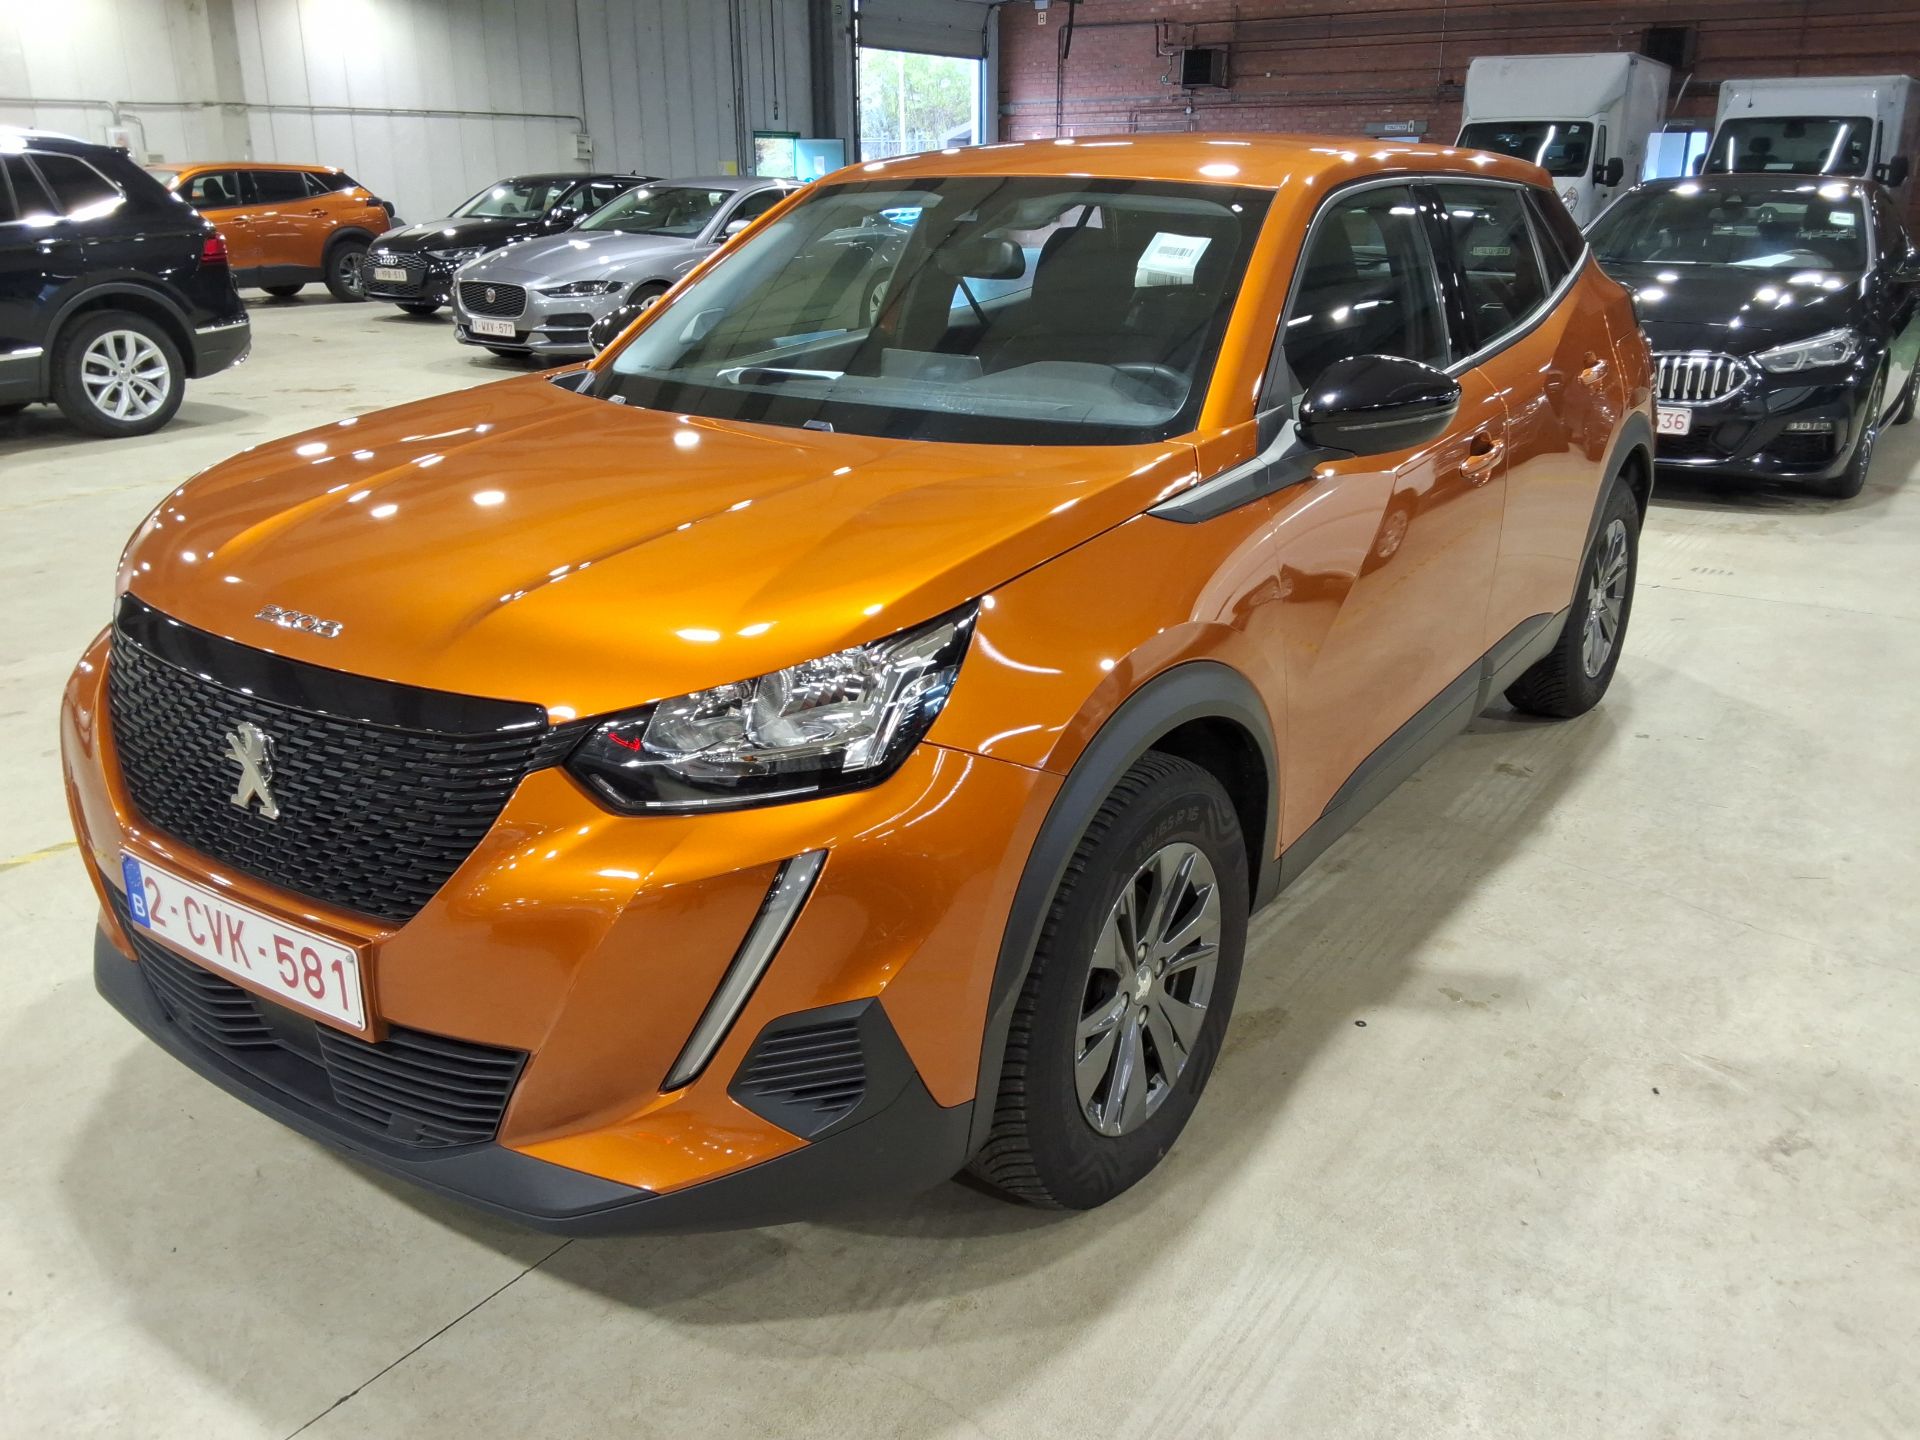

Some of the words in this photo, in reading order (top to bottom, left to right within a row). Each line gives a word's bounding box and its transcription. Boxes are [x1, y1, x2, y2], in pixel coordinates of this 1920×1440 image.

[254, 603, 344, 639] 2008
[132, 893, 146, 918] B
[144, 875, 350, 1012] 2-CVK-581
